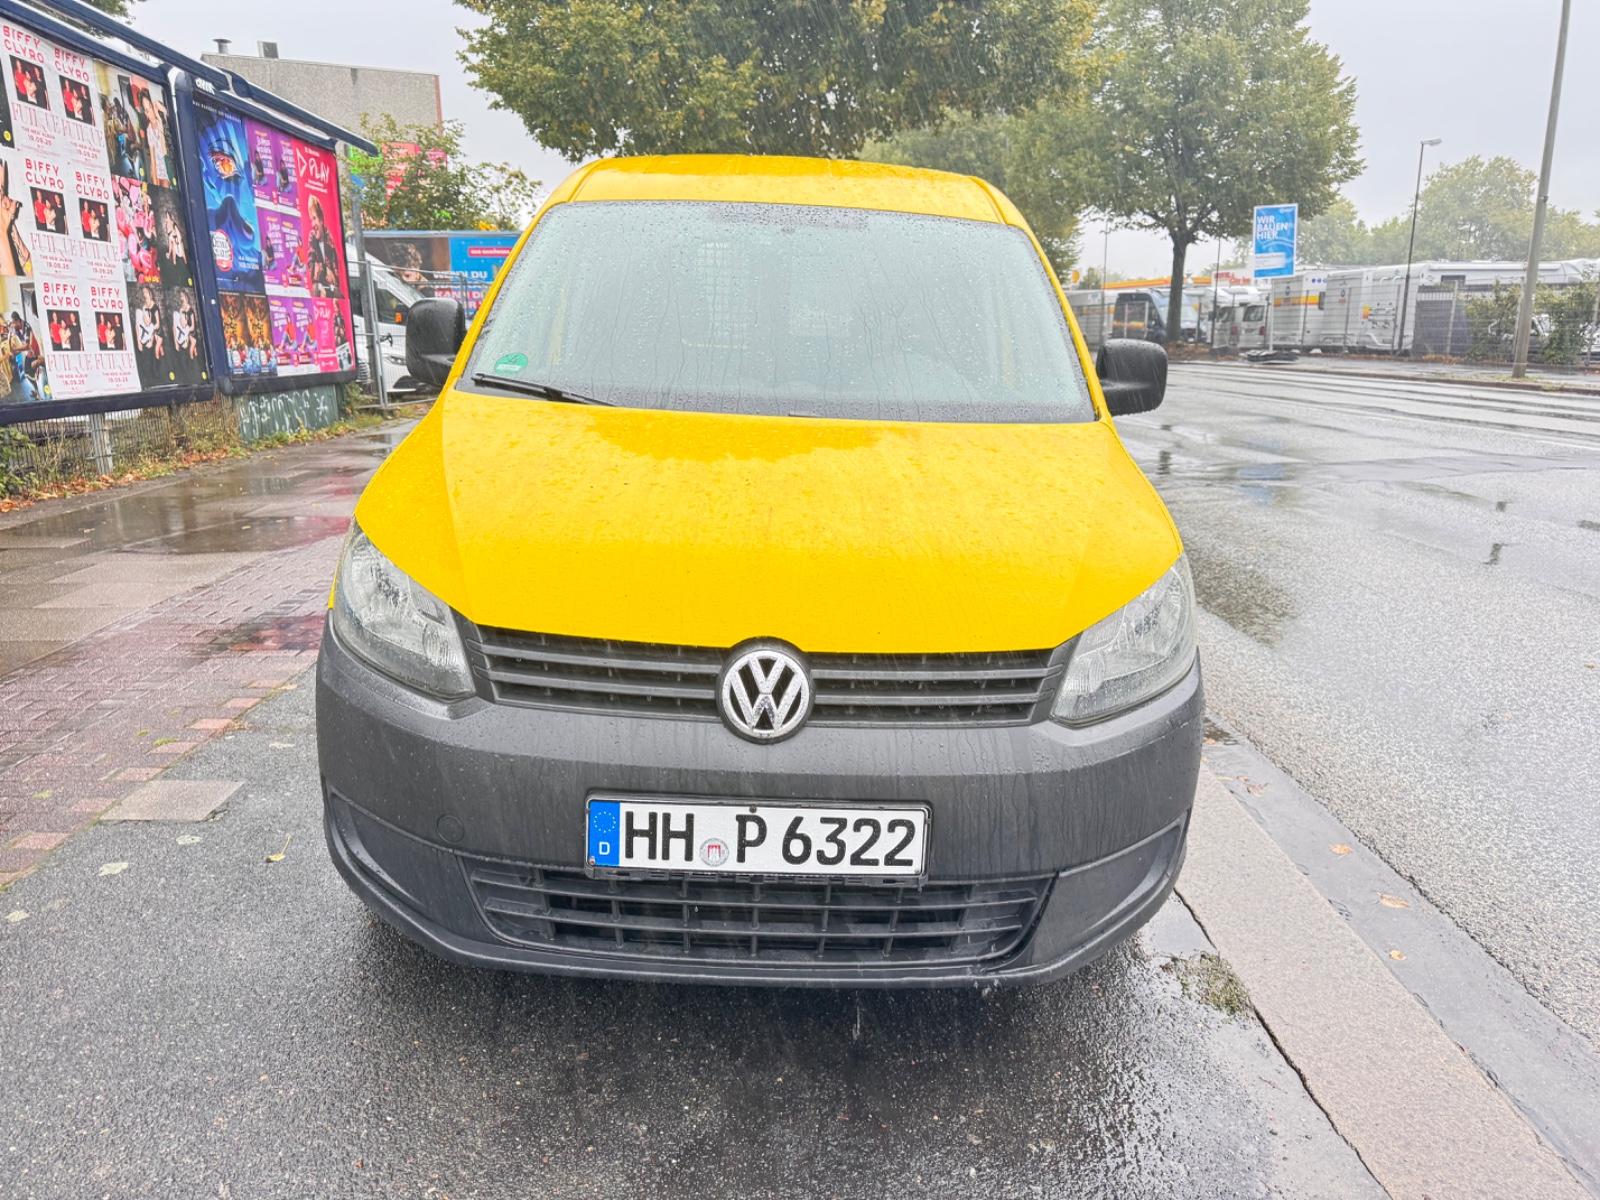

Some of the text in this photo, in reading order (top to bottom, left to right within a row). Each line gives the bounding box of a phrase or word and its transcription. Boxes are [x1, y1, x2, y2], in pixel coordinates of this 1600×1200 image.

[3, 26, 41, 48] BIFFY
[4, 40, 45, 64] CLYRO
[54, 48, 86, 69] BIFFY
[55, 61, 90, 82] CLYRO
[25, 158, 59, 176] BIFFY
[25, 172, 65, 190] CLYRO
[75, 171, 105, 188] BIFFY
[76, 184, 109, 200] CLYRO
[1256, 215, 1275, 224] WIR
[1257, 223, 1289, 232] BAUEN
[471, 271, 488, 279] DU
[43, 282, 76, 295] BIFFY
[90, 286, 120, 298] BIFFY
[43, 296, 81, 307] CLYRO
[91, 298, 124, 310] CLYRO
[724, 652, 807, 736] VW
[625, 811, 916, 867] HH P 6322
[598, 841, 611, 855] D
